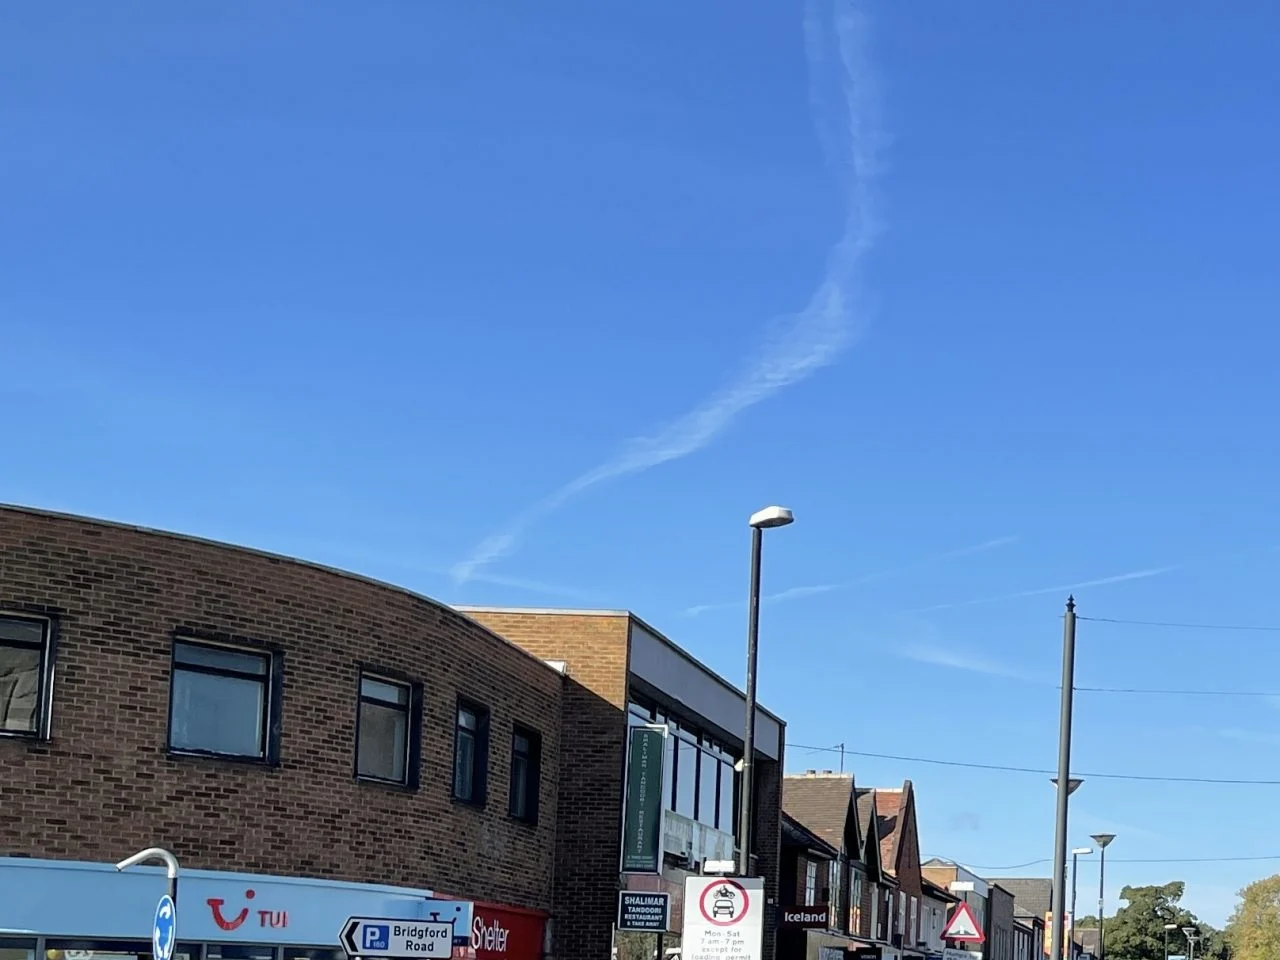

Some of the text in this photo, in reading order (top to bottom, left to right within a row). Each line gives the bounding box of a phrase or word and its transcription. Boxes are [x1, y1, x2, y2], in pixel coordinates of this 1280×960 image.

[624, 896, 665, 906] SHALIMAR
[627, 906, 662, 914] TANDOORI
[257, 910, 288, 928] TUI
[624, 913, 663, 921] RESTAURANT
[784, 911, 826, 922] Iceland
[365, 927, 381, 948] P
[393, 925, 448, 940] Bridgford
[472, 916, 510, 952] Shelter
[405, 940, 434, 952] Road
